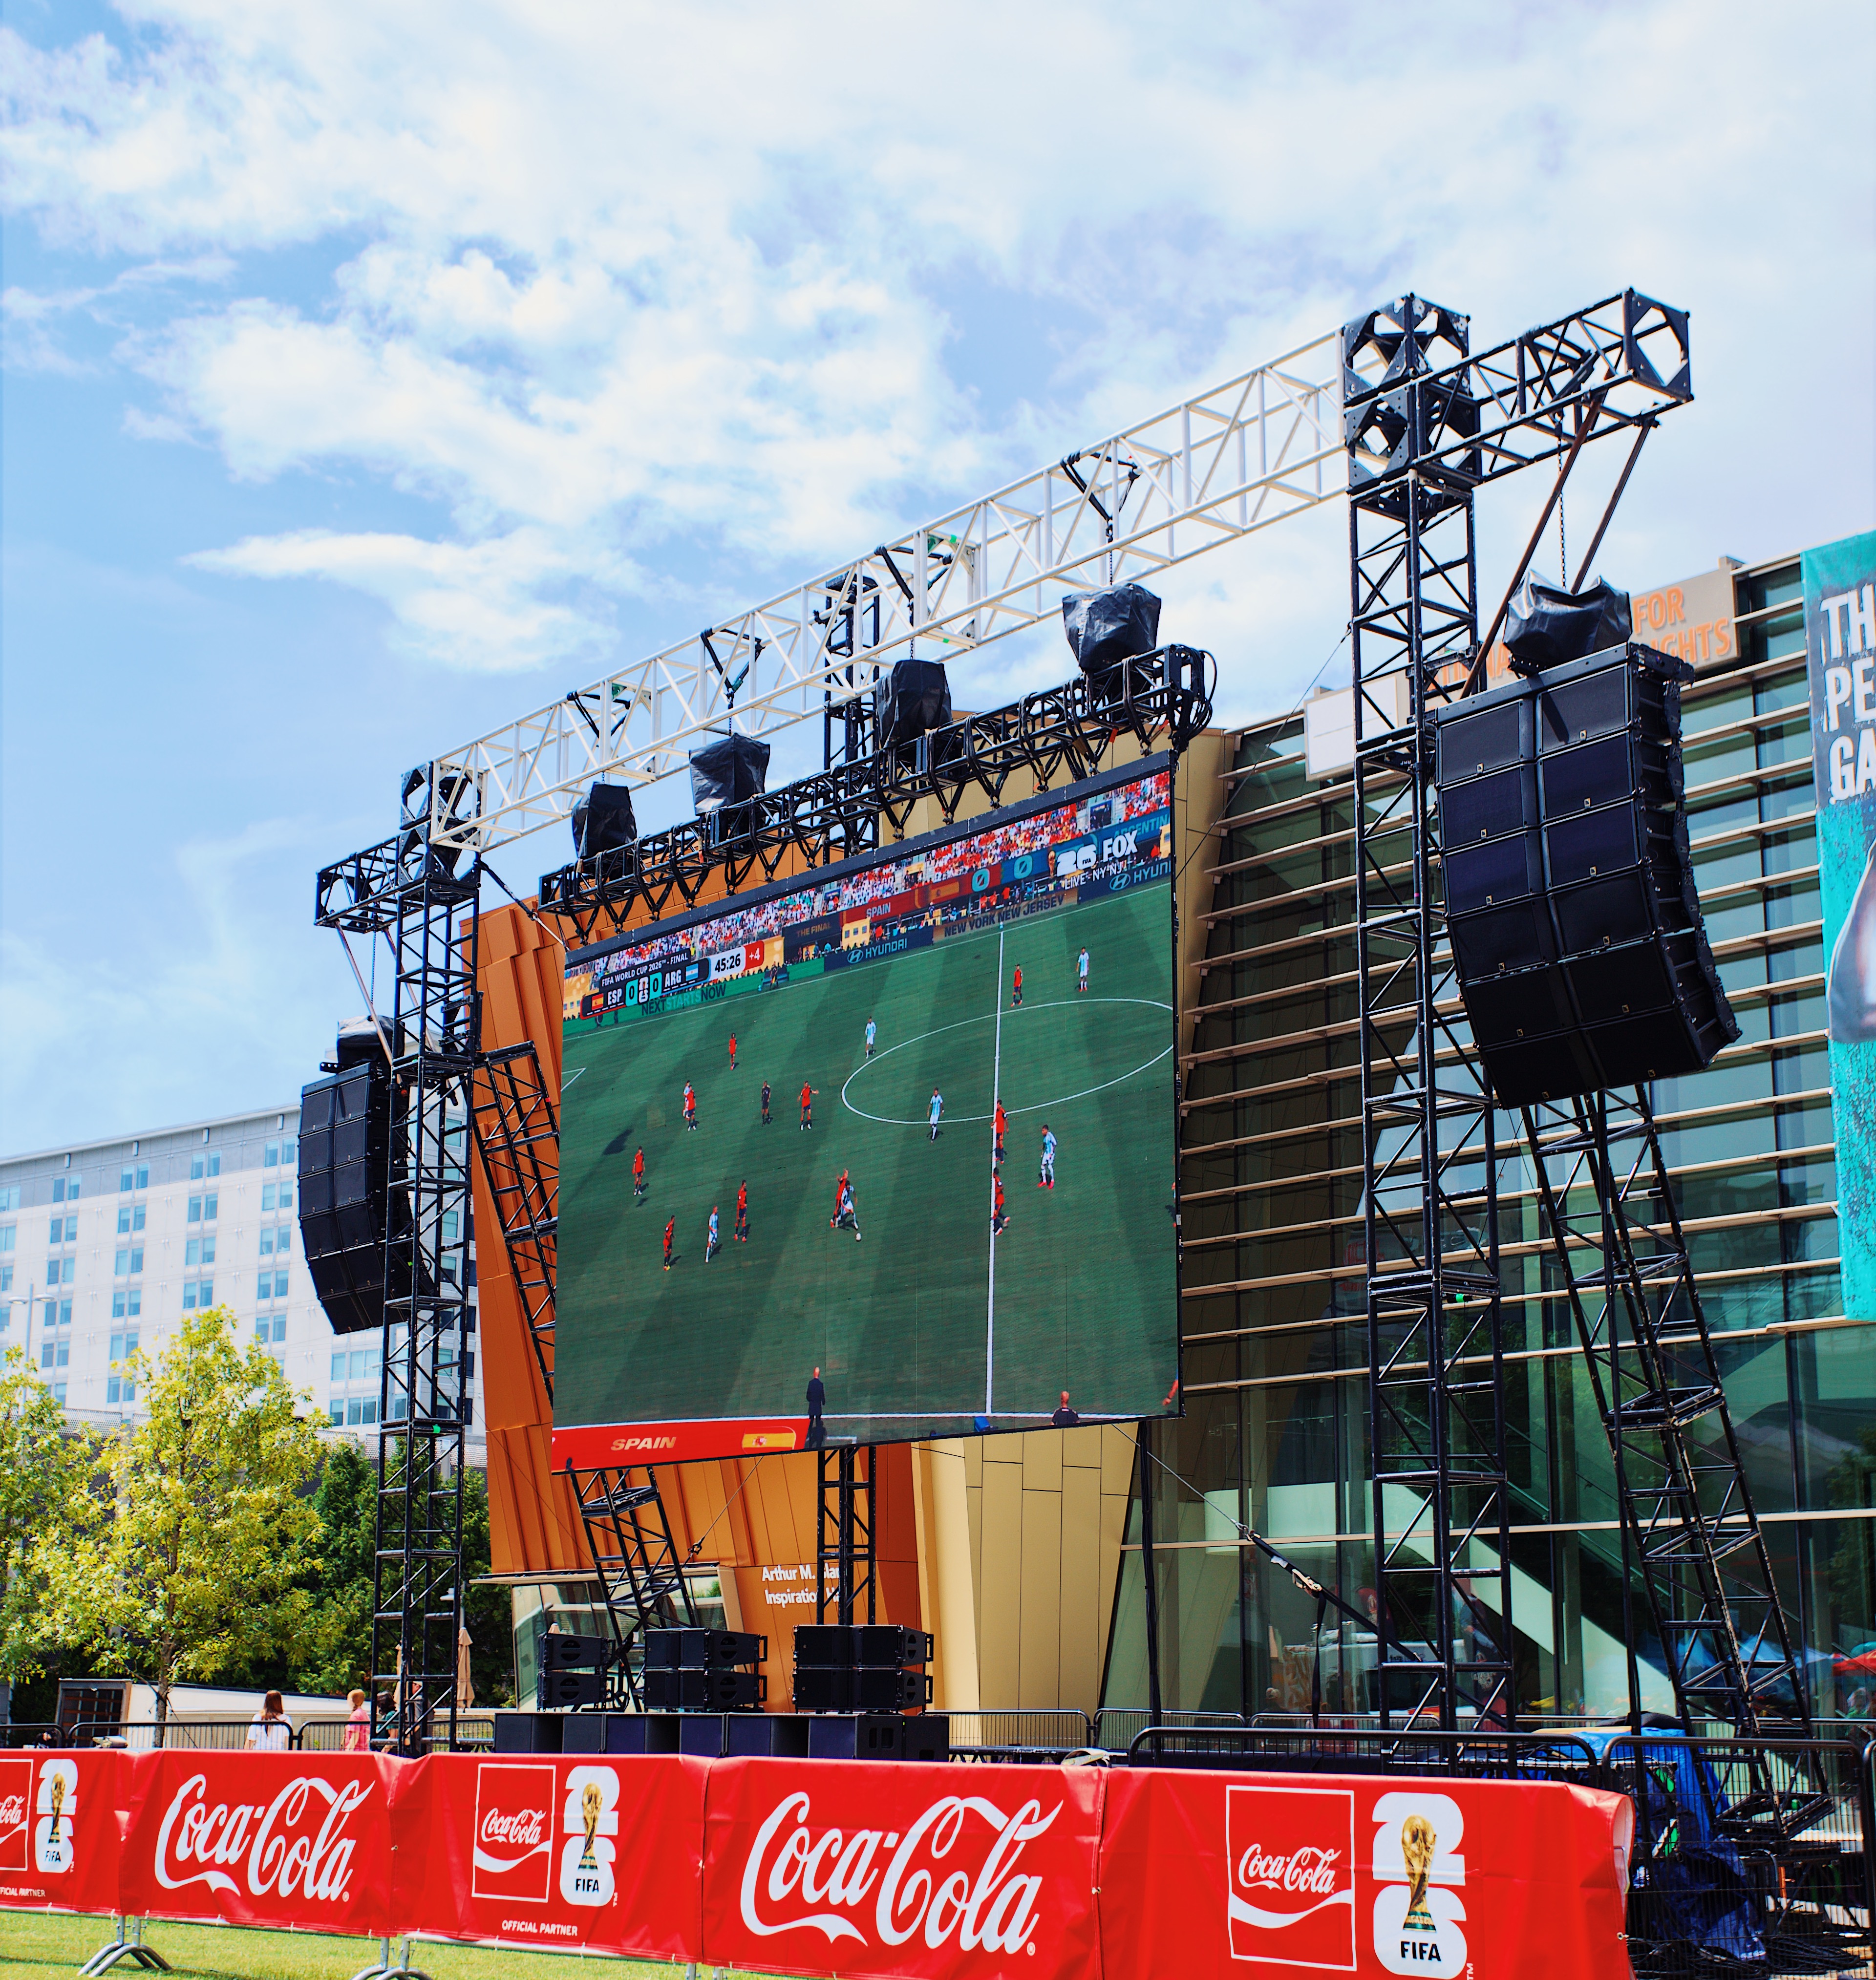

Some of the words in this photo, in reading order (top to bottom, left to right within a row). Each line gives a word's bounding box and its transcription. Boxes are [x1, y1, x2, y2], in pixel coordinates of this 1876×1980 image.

[1632, 586, 1684, 635] FOR
[1819, 583, 1876, 659] TH
[1650, 617, 1731, 663] GHTS
[1103, 830, 1138, 863] FOX
[866, 902, 891, 918] SPAIN
[1114, 813, 1170, 839] AENTIN
[1065, 873, 1086, 890] LIVE
[1093, 866, 1107, 881] NY
[1134, 861, 1171, 883] HYUN
[797, 927, 810, 937] THE
[811, 922, 831, 934] FINAL
[944, 924, 966, 937] NEW
[969, 914, 996, 931] YORK
[998, 907, 1021, 922] NEW
[1023, 894, 1064, 915] JERSEY
[866, 938, 907, 958] HYUNDAI
[602, 977, 614, 986] FIFA
[615, 969, 635, 982] WORLD
[637, 965, 648, 976] CUP
[670, 953, 688, 965] FINAL
[608, 988, 622, 1005] ESP
[629, 985, 635, 1000] 0
[653, 978, 659, 992] 0
[664, 970, 682, 987] ARG
[715, 953, 741, 973] 45:26
[749, 948, 760, 960] +4
[611, 1436, 677, 1450] SPAIN
[762, 1565, 797, 1581] Arthur
[799, 1564, 815, 1580] M.
[765, 1588, 817, 1608] Inspiratio
[154, 1774, 376, 1901] Coca-Cola
[481, 1808, 546, 1845] Coca-Cola
[45, 1851, 61, 1862] FIFA
[1238, 1844, 1342, 1894] Coca-Cola
[576, 1878, 599, 1892] FIFA
[741, 1791, 1064, 1954] Coca-Cola
[0, 1886, 18, 1896] FICIAL
[19, 1888, 46, 1897] PARTNER
[502, 1919, 537, 1933] OFFICIAL
[539, 1923, 578, 1937] PARTNER
[1400, 1940, 1441, 1961] FIFA
